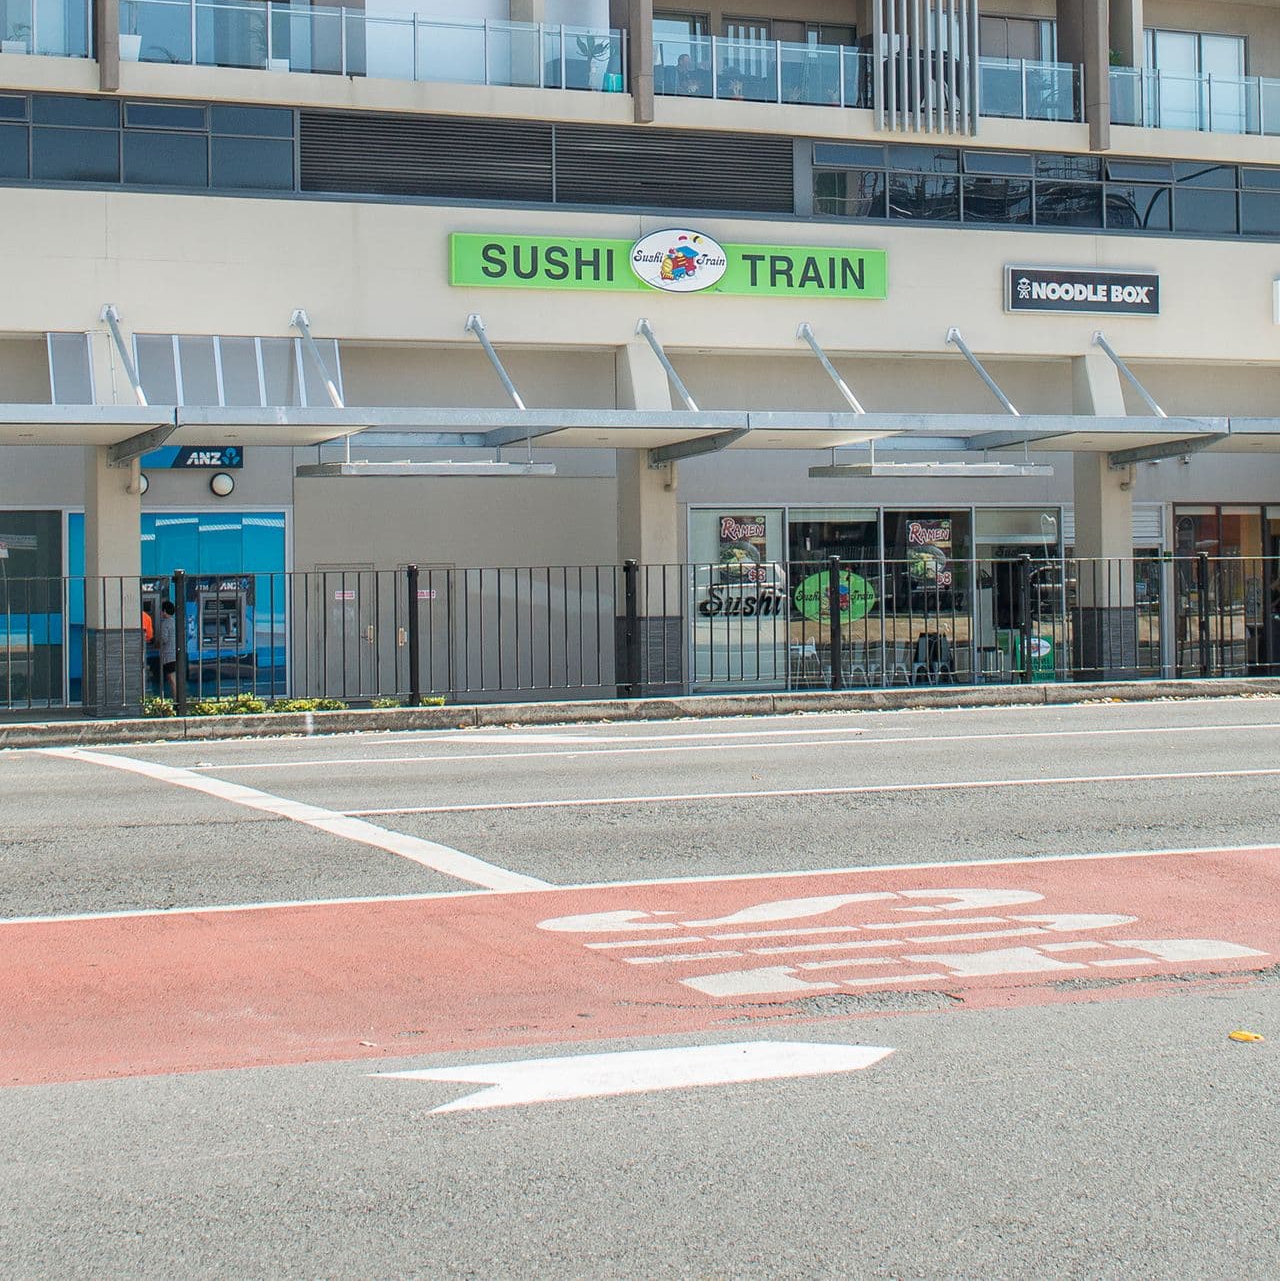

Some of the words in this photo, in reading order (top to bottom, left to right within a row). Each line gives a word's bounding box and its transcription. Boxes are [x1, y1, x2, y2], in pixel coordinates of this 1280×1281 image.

[481, 243, 615, 282] SUSHI
[633, 249, 664, 263] Sushi
[696, 253, 726, 266] Train
[741, 254, 865, 290] TRAIN
[1031, 282, 1108, 302] NOODLE
[186, 451, 222, 465] ANZ
[721, 517, 765, 541] RAMEN
[909, 522, 951, 545] RAMEN
[698, 583, 784, 618] Sushi
[536, 887, 1270, 998] BUS
